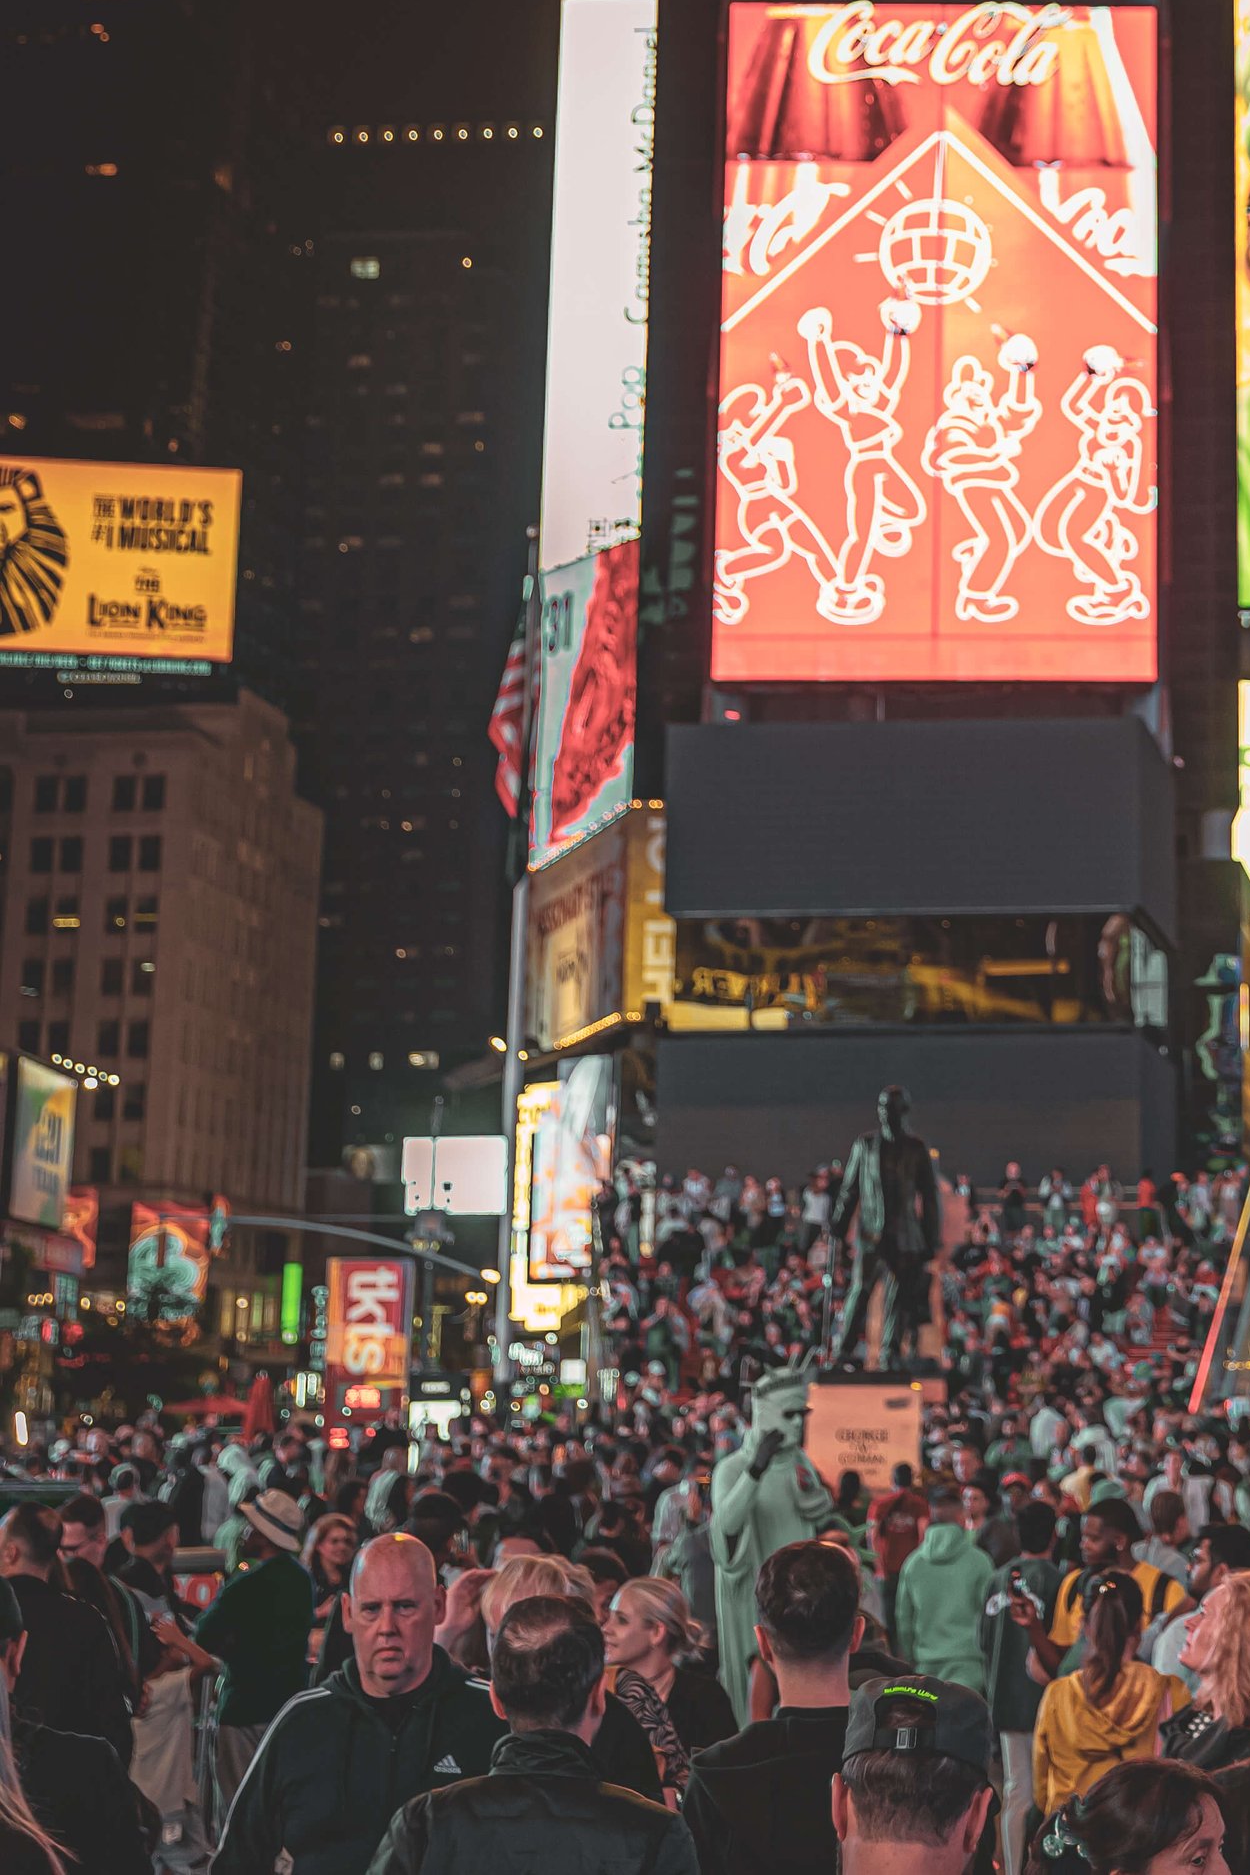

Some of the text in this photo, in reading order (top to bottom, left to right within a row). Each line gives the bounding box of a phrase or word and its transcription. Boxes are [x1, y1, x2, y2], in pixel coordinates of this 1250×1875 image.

[807, 0, 1069, 87] Coca-Cola
[118, 525, 211, 556] MUSICAL
[119, 495, 214, 527] WORLD'S
[345, 1265, 400, 1374] tkts
